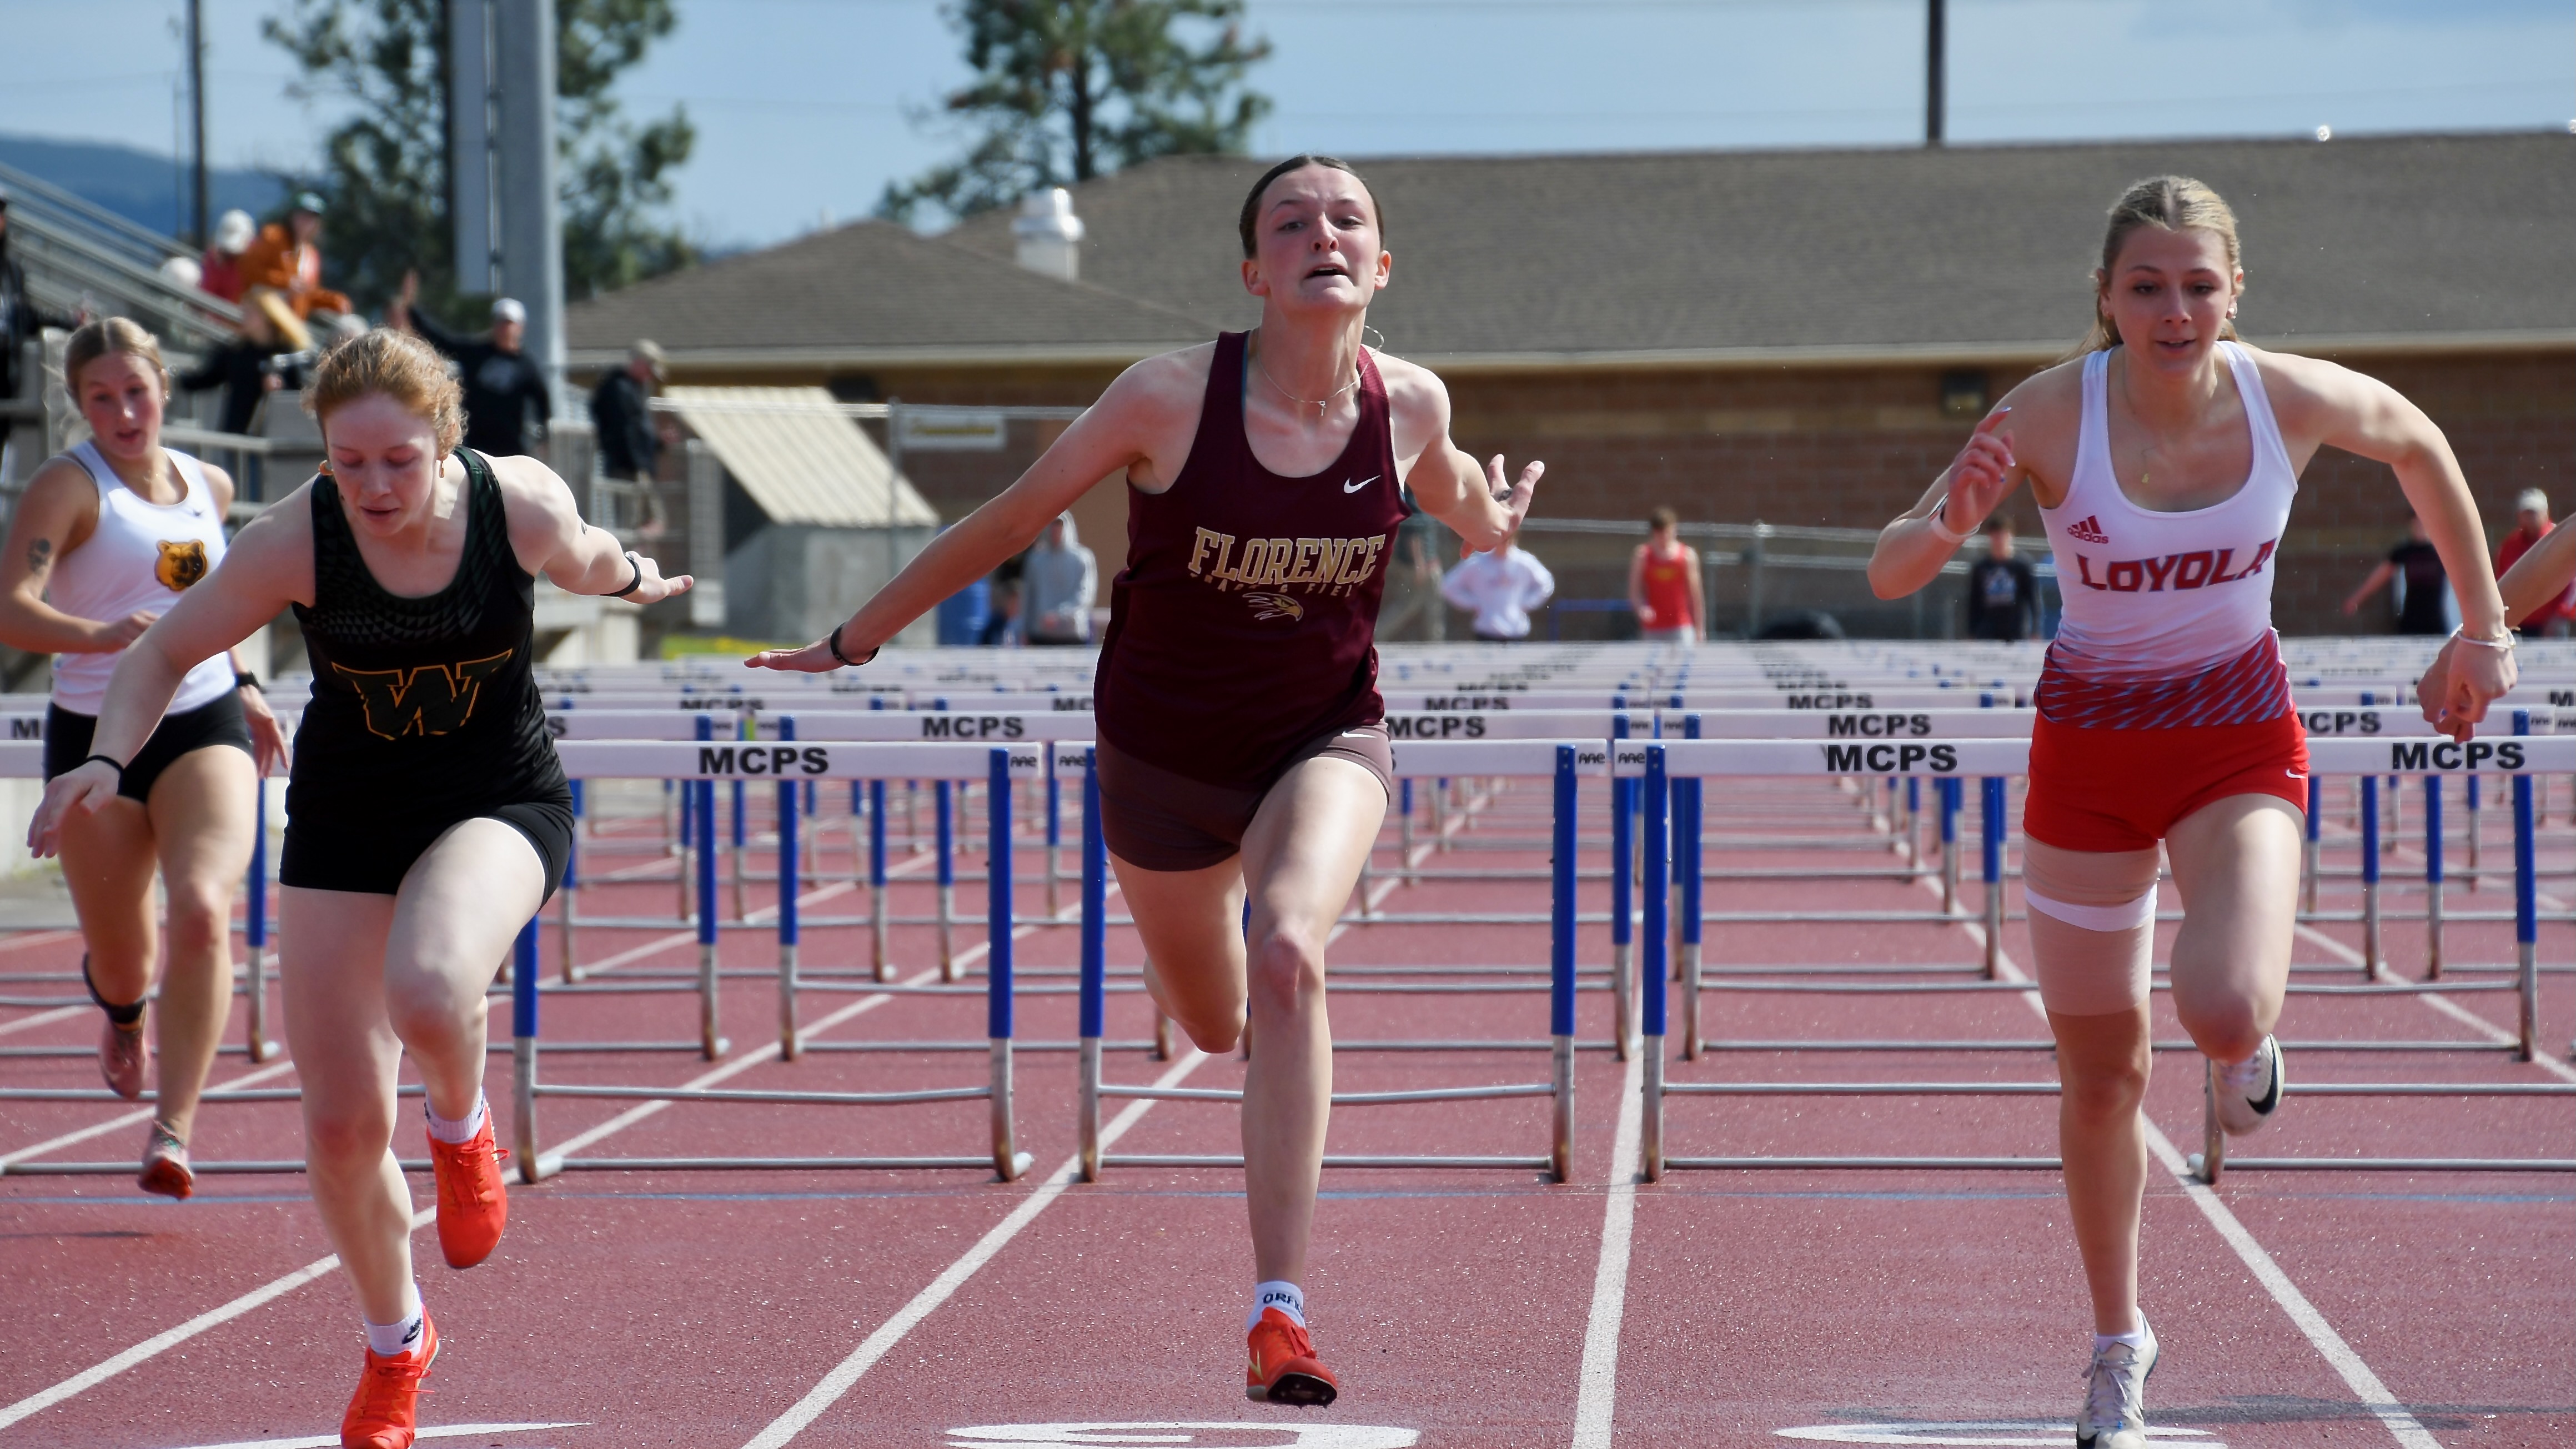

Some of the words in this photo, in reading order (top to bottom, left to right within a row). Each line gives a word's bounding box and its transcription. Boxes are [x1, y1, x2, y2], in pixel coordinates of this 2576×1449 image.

[2067, 525, 2109, 544] adidas
[1188, 527, 1386, 585] FLORENCE
[2076, 537, 2277, 592] LOYOLA
[1425, 696, 1510, 710] MCPS
[1787, 693, 1874, 709] MCPS
[922, 716, 1024, 738] MCPS
[1385, 715, 1487, 738] MCPS
[1828, 714, 1931, 736] MCPS
[699, 746, 829, 775] MCPS
[1827, 744, 1958, 772] MCPS
[2392, 742, 2525, 770] MCPS
